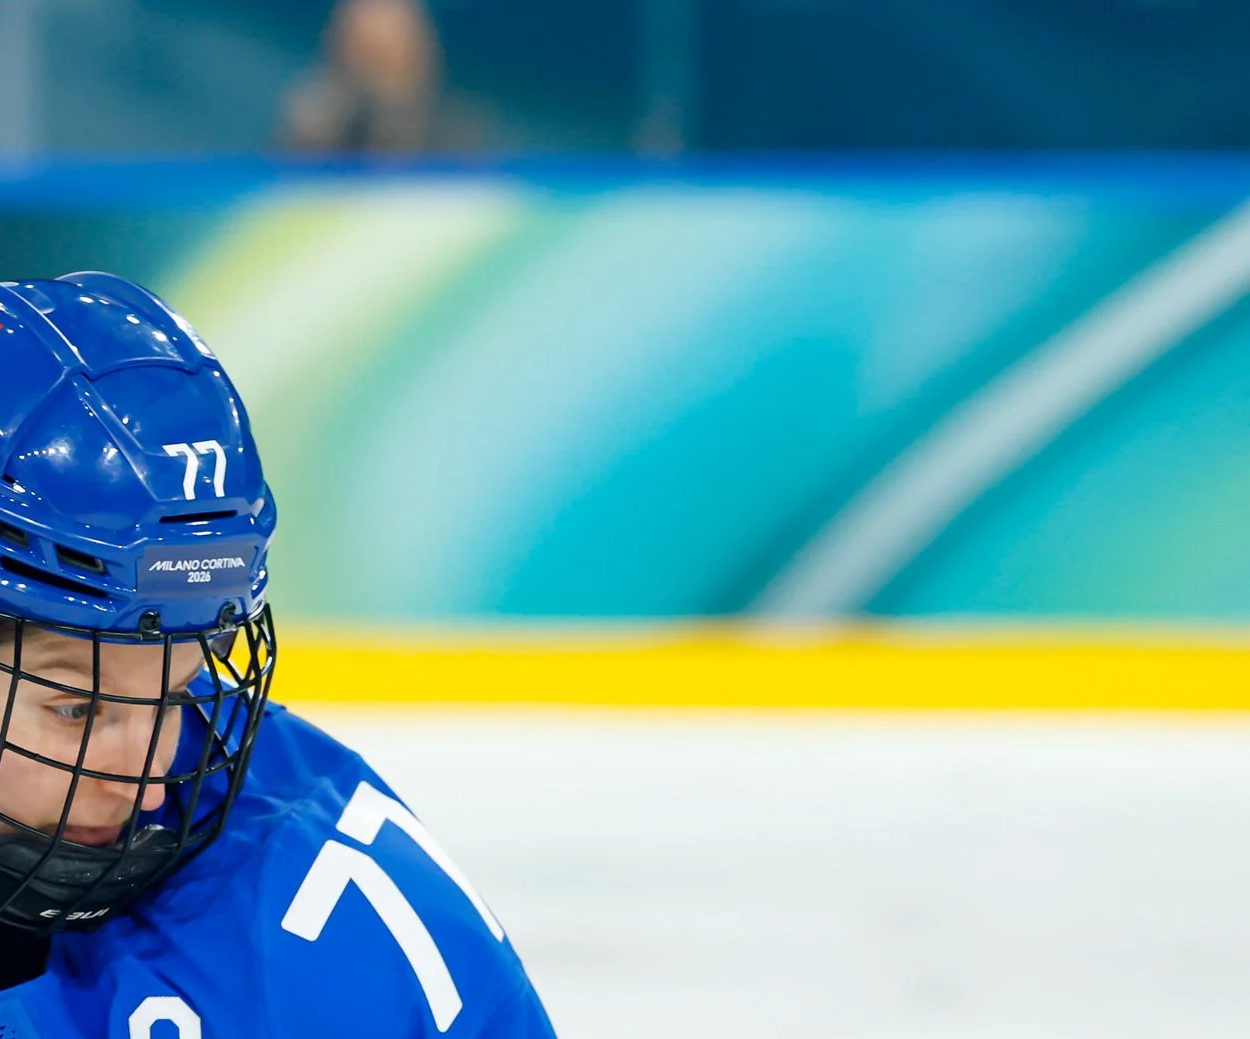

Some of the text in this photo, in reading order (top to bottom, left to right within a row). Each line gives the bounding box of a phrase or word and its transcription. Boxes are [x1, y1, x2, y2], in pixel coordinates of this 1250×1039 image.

[162, 440, 226, 499] 77
[149, 557, 245, 571] MILANO CORTINA
[187, 571, 211, 583] 2026
[281, 781, 504, 1032] 77
